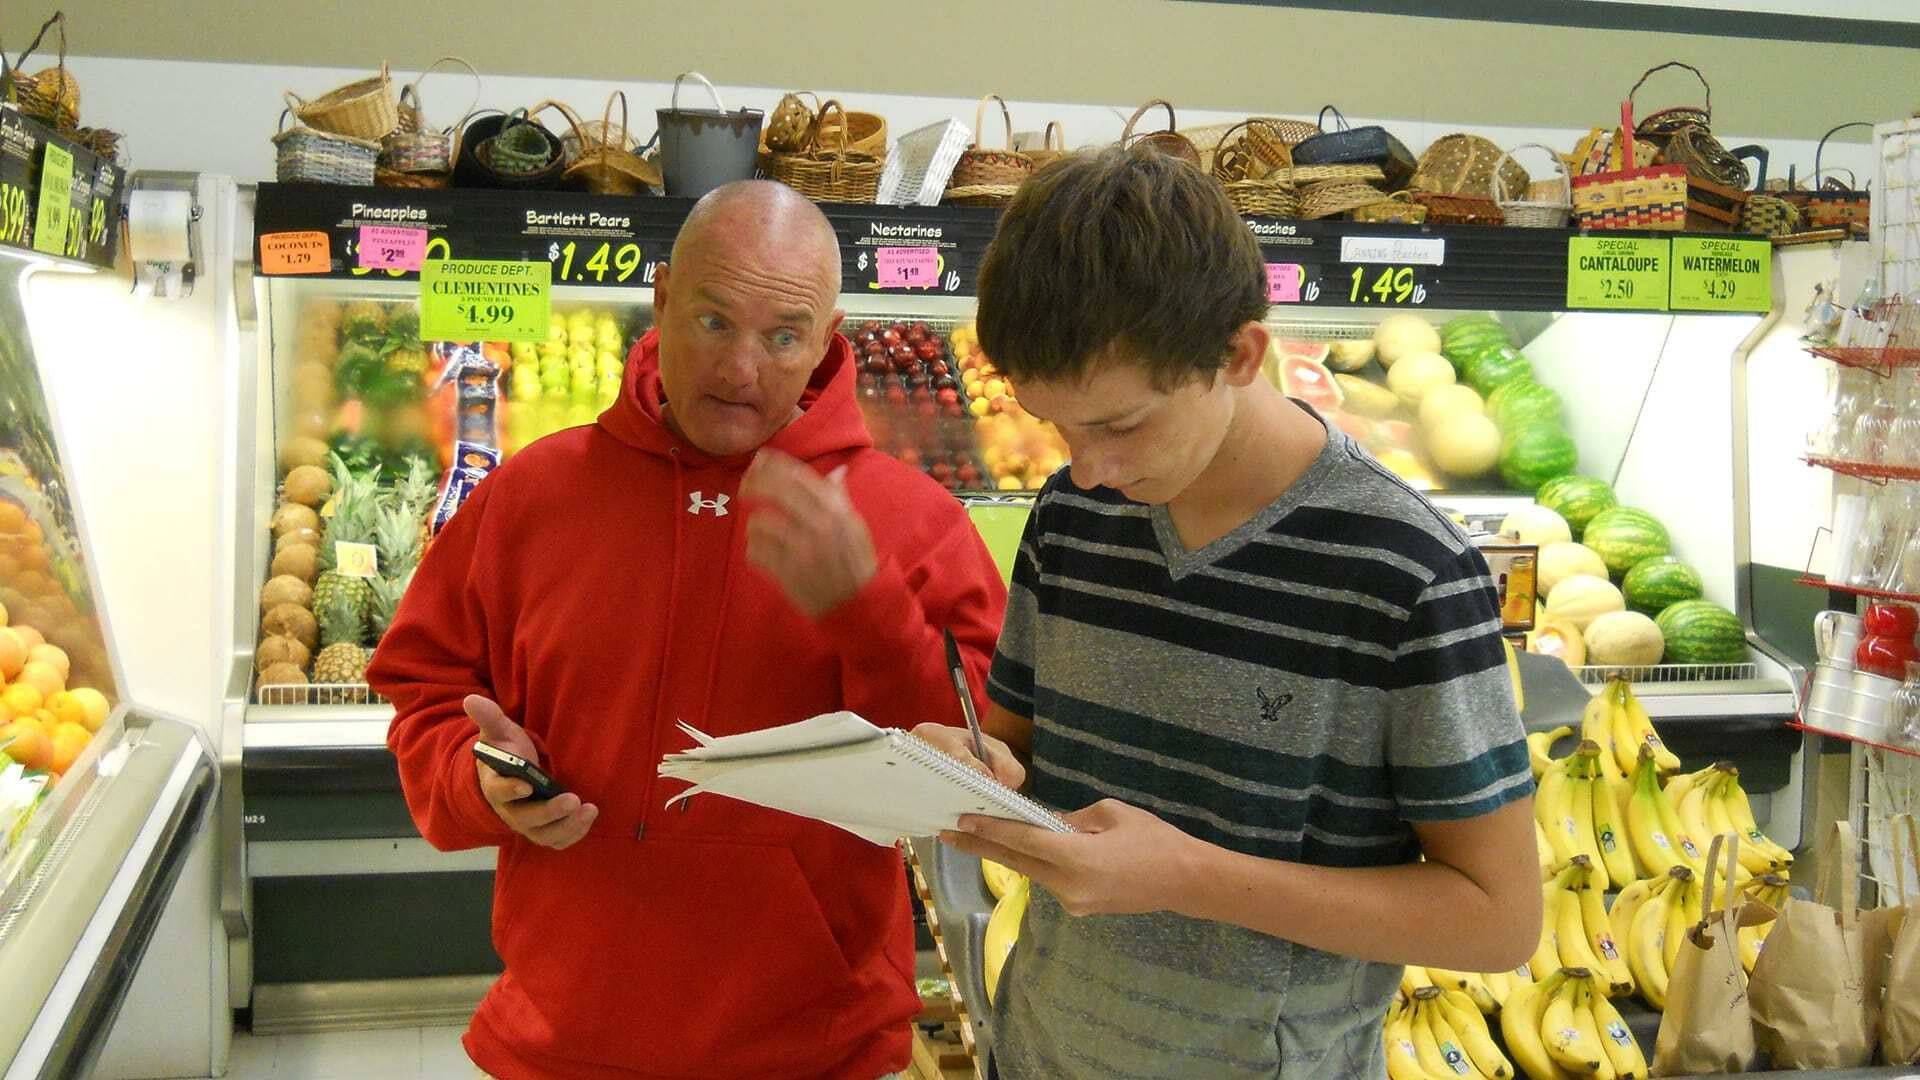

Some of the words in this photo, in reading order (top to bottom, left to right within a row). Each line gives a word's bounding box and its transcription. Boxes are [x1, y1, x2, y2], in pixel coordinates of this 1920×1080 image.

[352, 203, 427, 220] Pineapples
[526, 210, 586, 226] Bartlett
[589, 212, 631, 228] Pears
[871, 222, 943, 237] Nectarines
[267, 241, 323, 250] COCONUTS
[1596, 240, 1640, 251] SPECIAL
[1700, 240, 1742, 252] SPECIAL
[441, 264, 497, 276] PRODUCE
[500, 265, 534, 277] DEPT.
[1579, 256, 1659, 273] CANTALOUPE
[1683, 256, 1760, 274] WATERMELON
[432, 280, 540, 297] CLEMENTINES
[945, 270, 960, 292] lb
[1350, 266, 1414, 303] 1.49
[1411, 284, 1427, 304] lb
[1600, 278, 1634, 300] $2.50
[1704, 278, 1736, 300] $4.29
[1304, 281, 1320, 302] lb
[457, 304, 515, 325] $4.99
